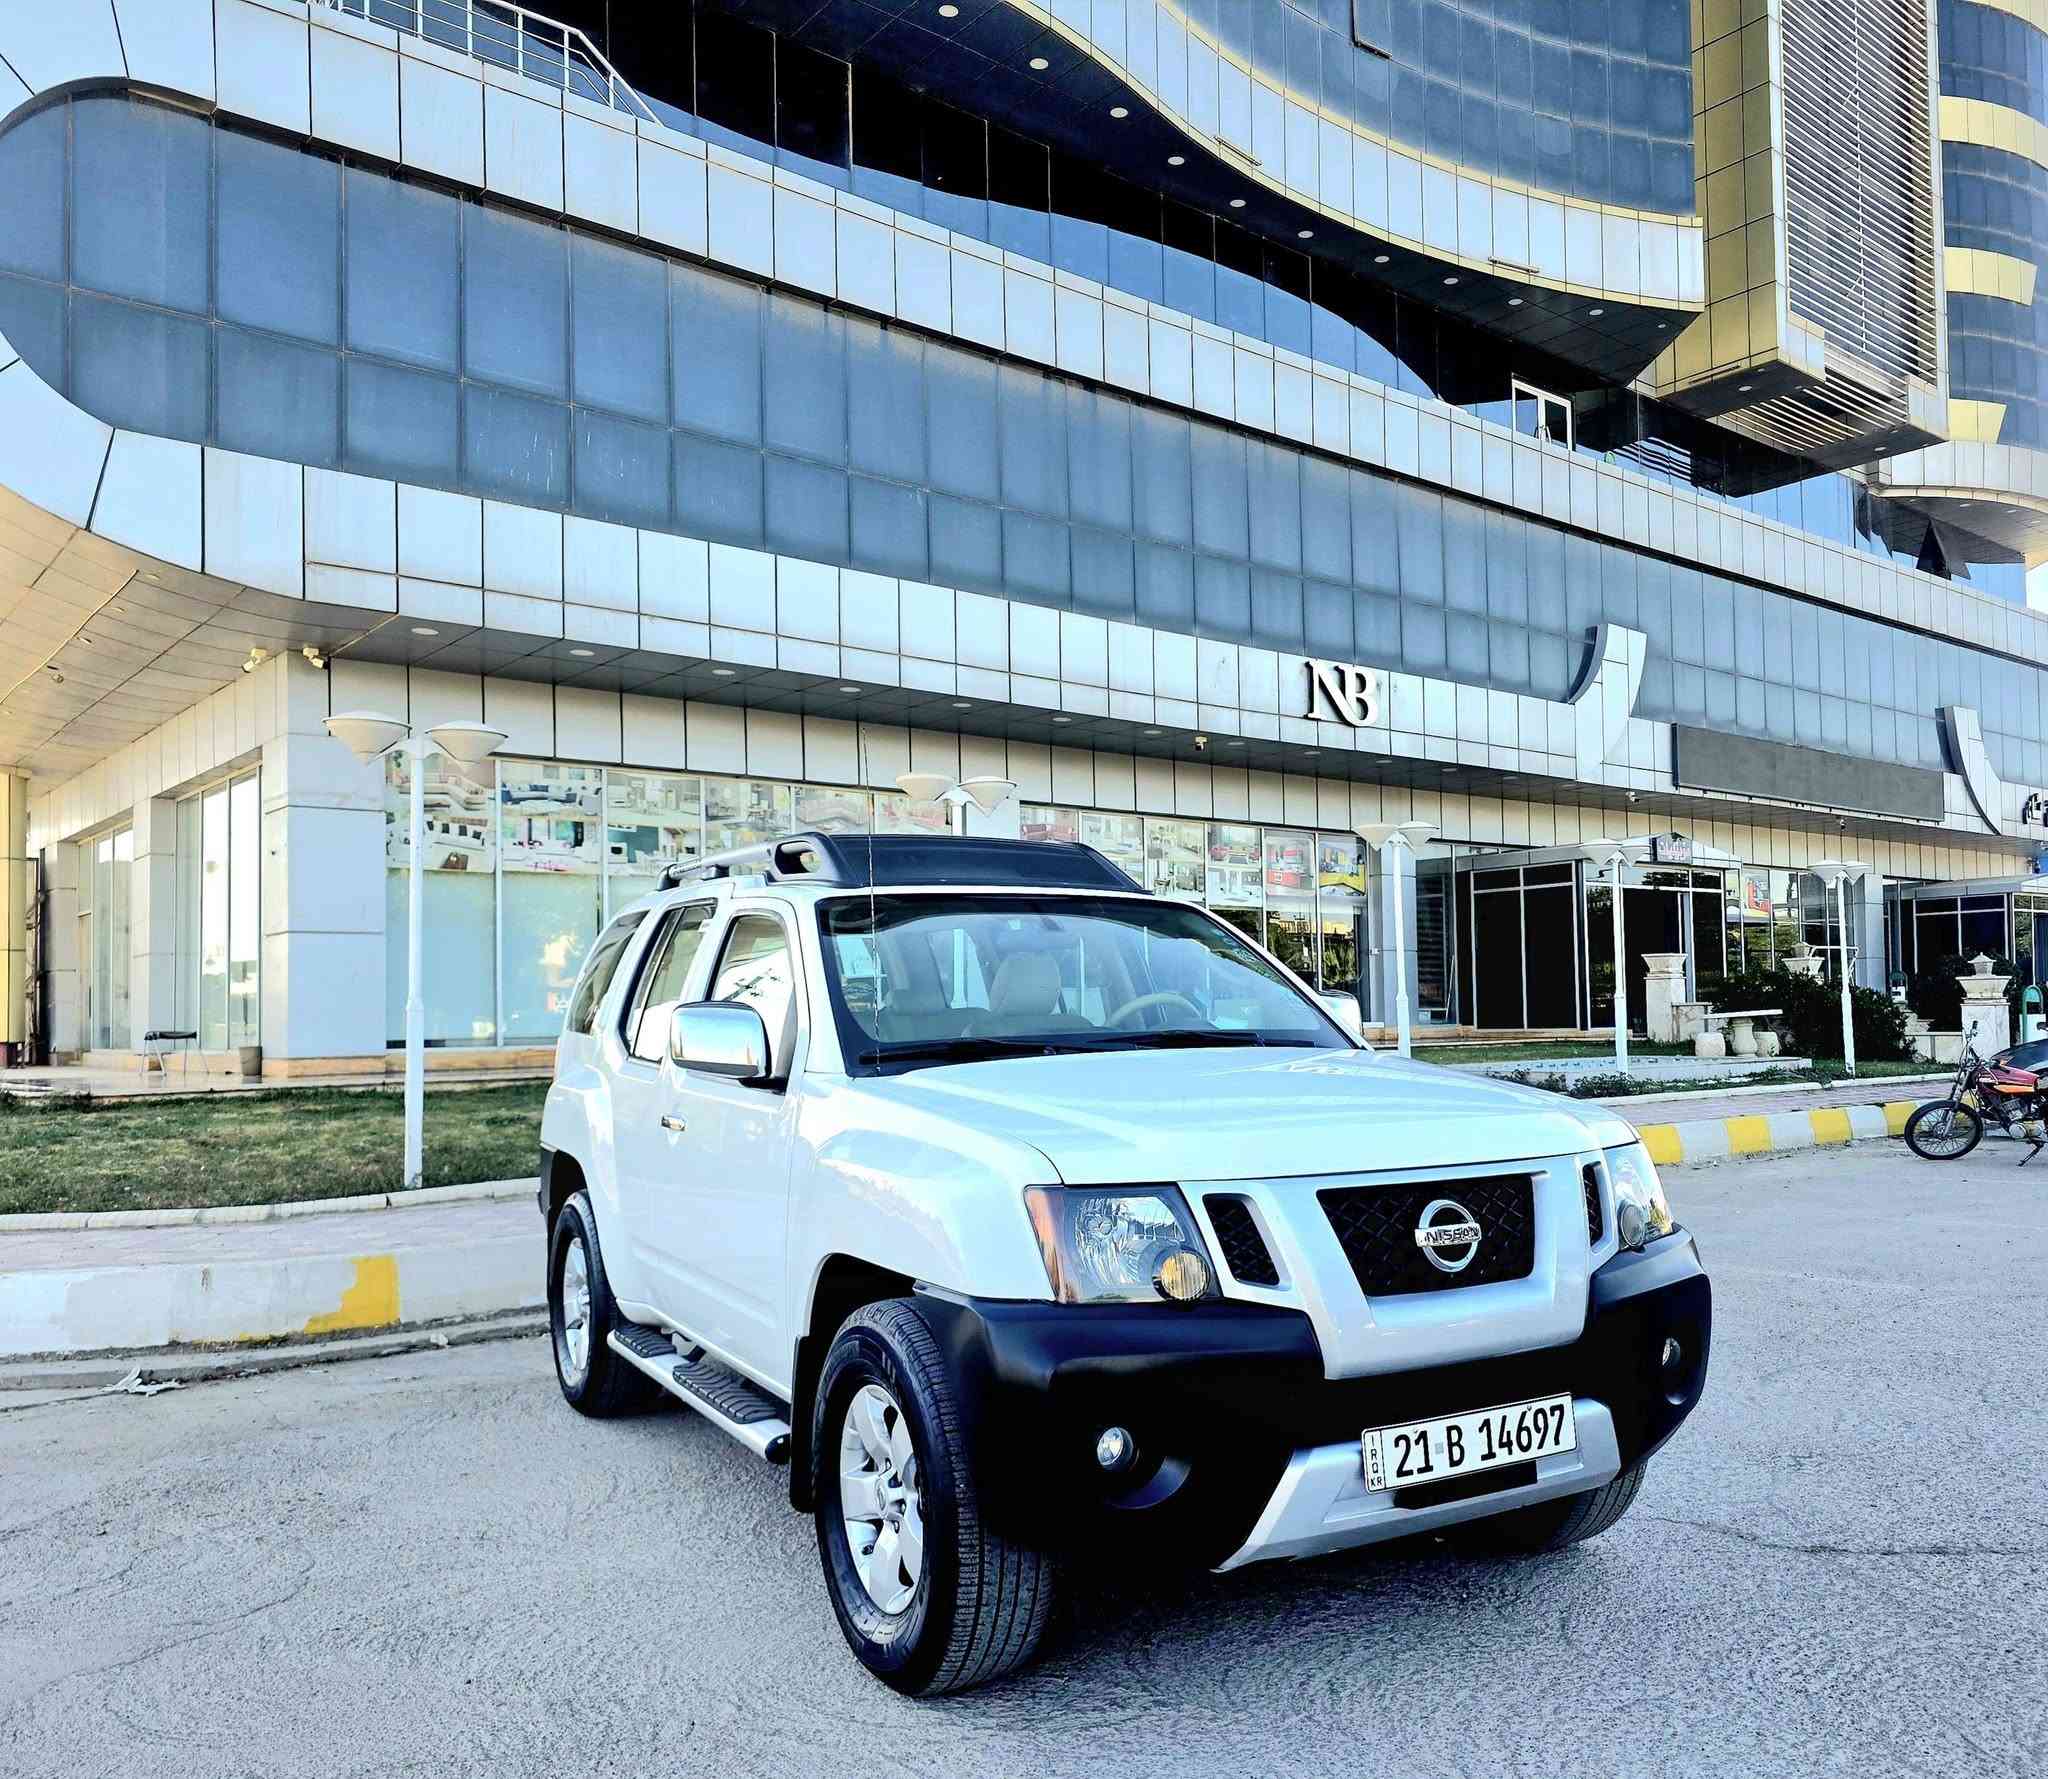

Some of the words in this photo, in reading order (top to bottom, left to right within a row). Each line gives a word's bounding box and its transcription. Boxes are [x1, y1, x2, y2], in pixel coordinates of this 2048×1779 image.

[1303, 658, 1378, 728] NB
[1424, 1225, 1480, 1243] NISSAN
[1393, 1430, 1434, 1478] 21
[1446, 1424, 1465, 1469] B
[1478, 1403, 1566, 1462] 14697
